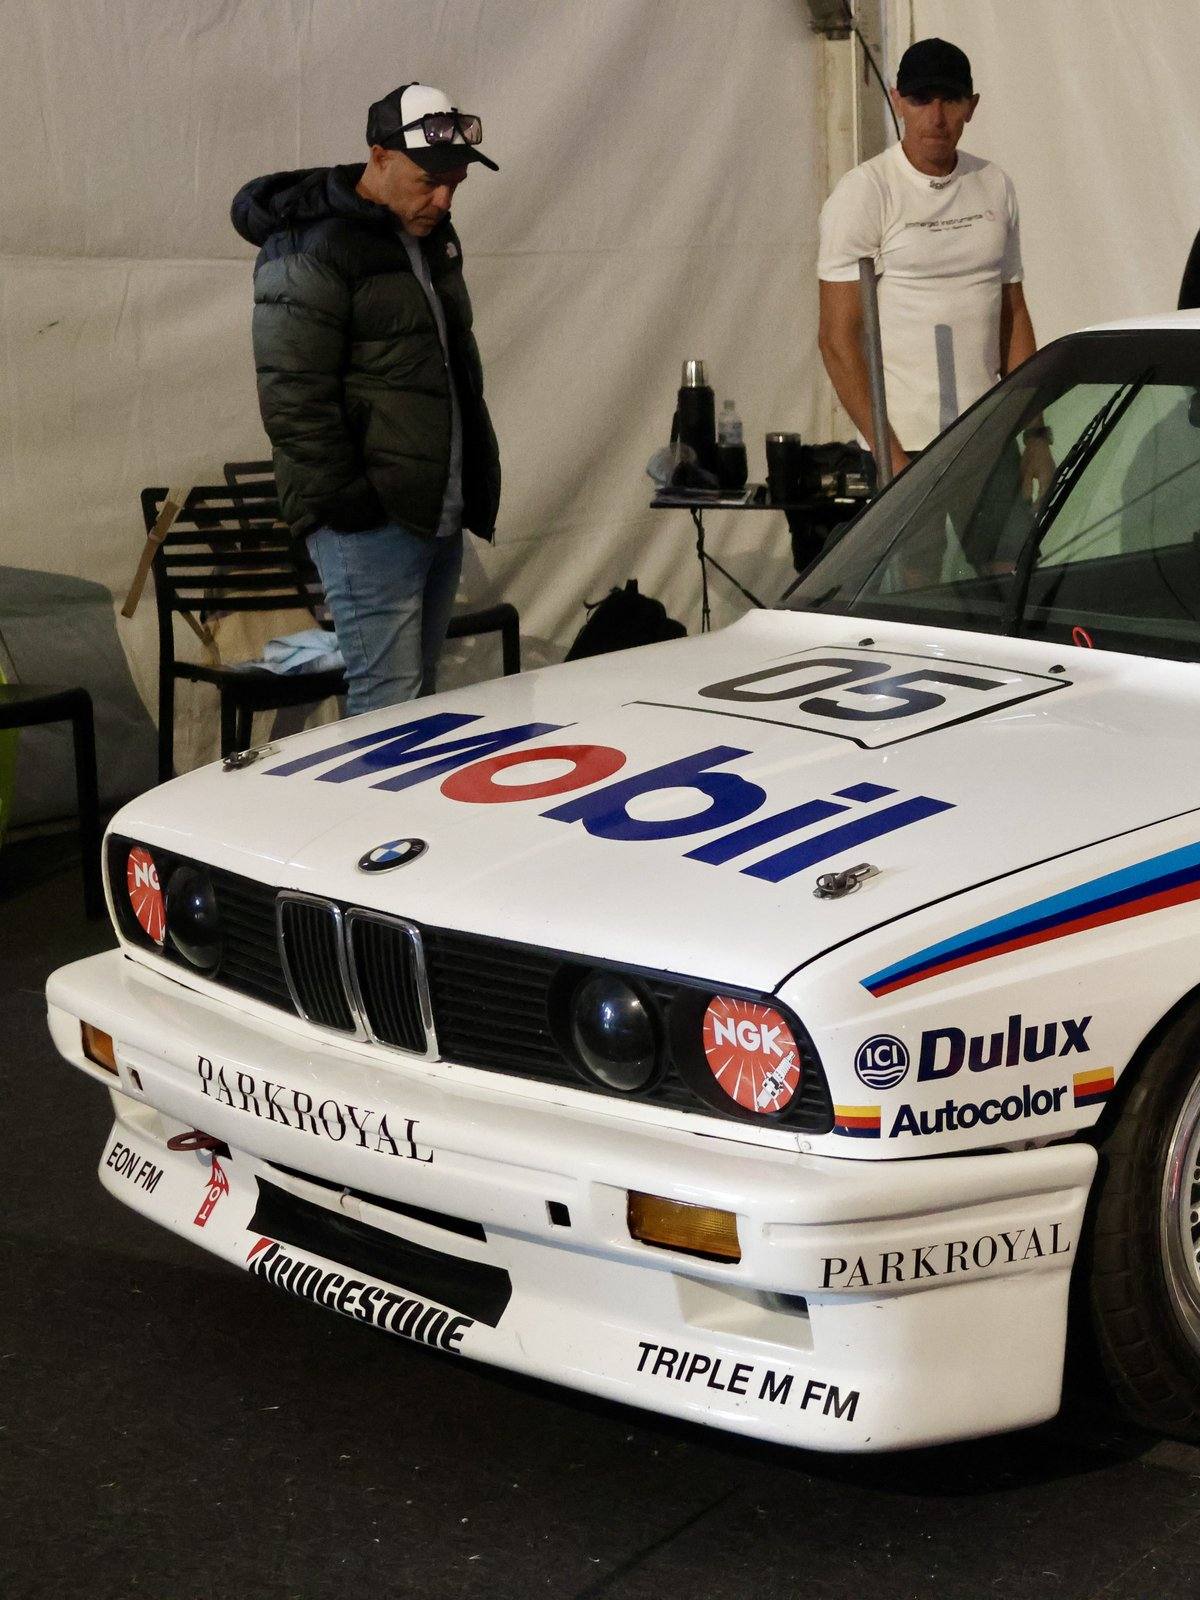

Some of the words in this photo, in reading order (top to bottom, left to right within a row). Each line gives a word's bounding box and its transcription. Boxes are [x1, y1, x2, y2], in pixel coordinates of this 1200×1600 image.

[697, 657, 1007, 722] 05
[262, 712, 958, 883] Mobil
[134, 862, 161, 891] NG
[713, 1017, 784, 1058] NGK
[865, 1045, 899, 1067] ICI
[916, 1013, 1093, 1083] Dulux
[197, 1055, 436, 1164] PARKROYAL
[888, 1084, 1069, 1138] Autocolor
[106, 1142, 138, 1180] EON
[134, 1163, 165, 1194] FM
[818, 1222, 1072, 1289] PARKROYAL
[246, 1237, 475, 1354] BRIDGESTONE
[636, 1341, 755, 1396] TRIPLE
[758, 1370, 795, 1405] M
[800, 1379, 861, 1422] FM
